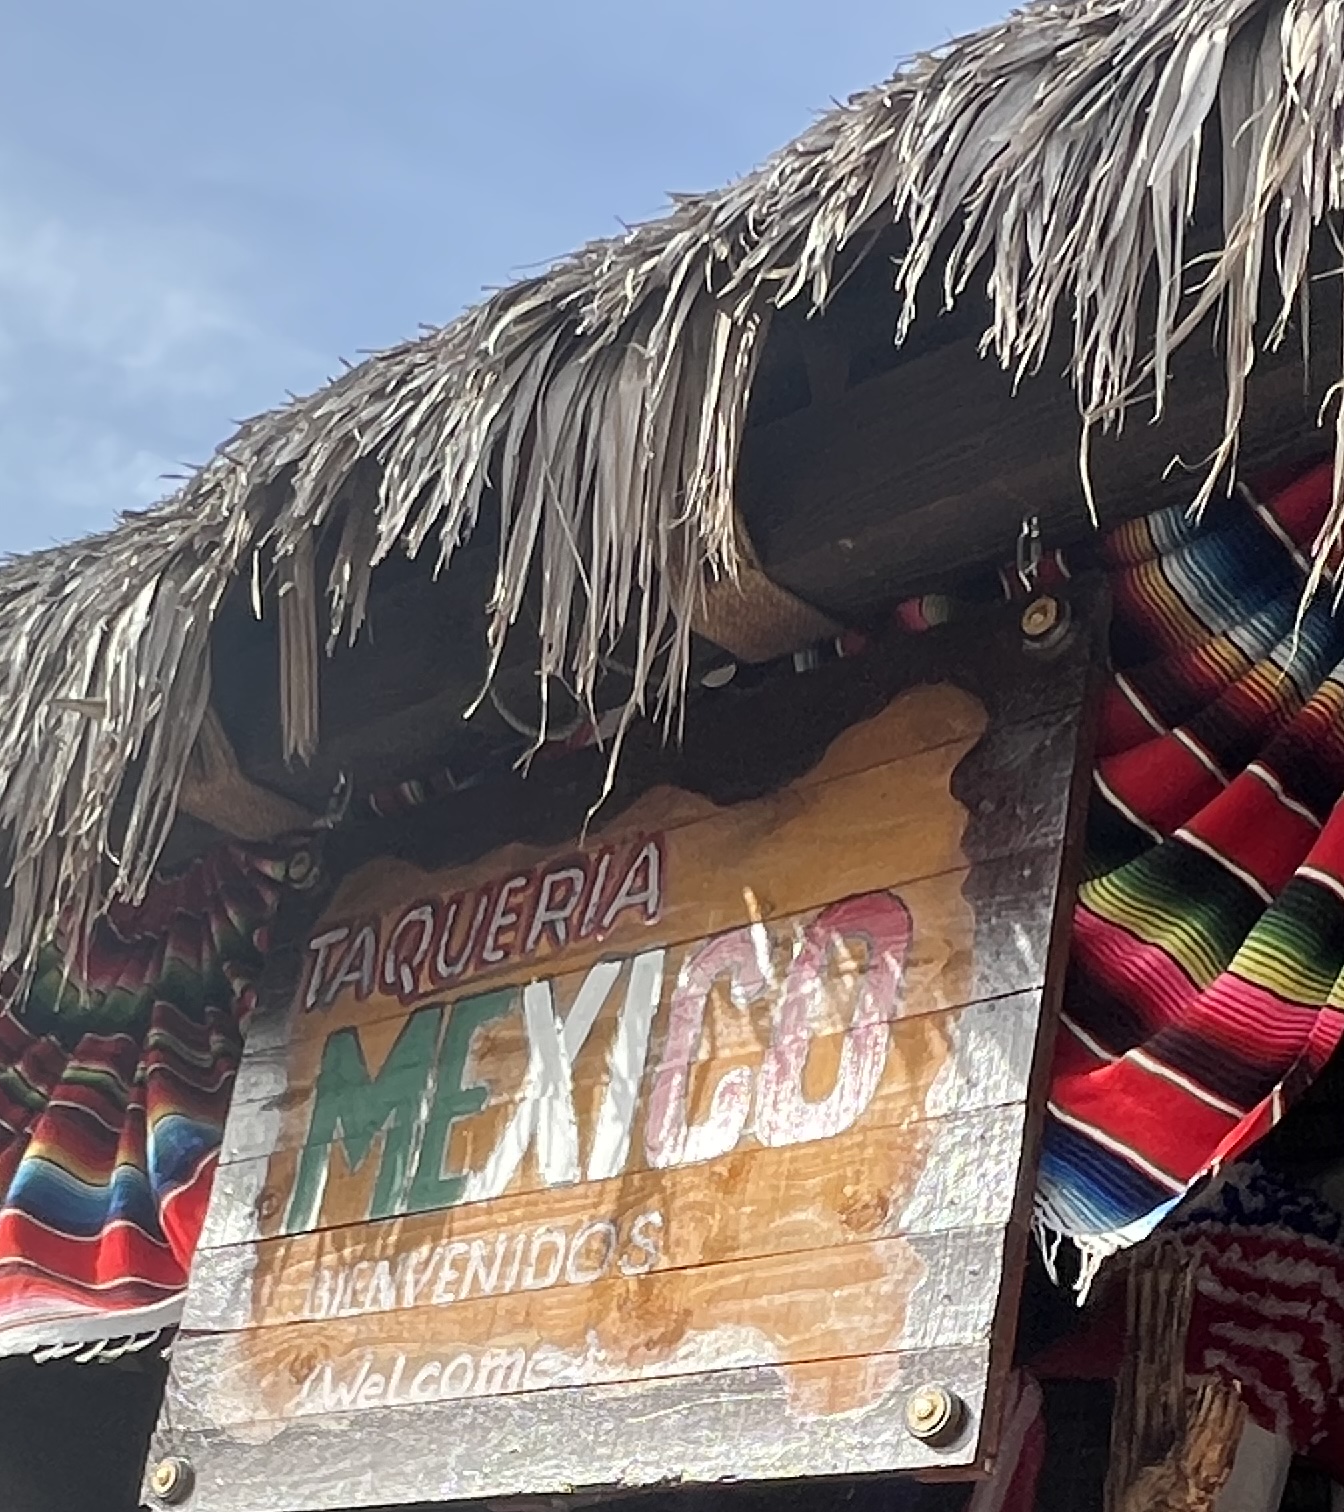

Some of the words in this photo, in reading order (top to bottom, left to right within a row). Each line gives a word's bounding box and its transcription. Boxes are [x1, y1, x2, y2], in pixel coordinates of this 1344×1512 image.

[304, 836, 664, 1010] TAQUERIA
[281, 888, 914, 1238] MEXICO
[301, 1210, 664, 1321] BIENVENIDOS
